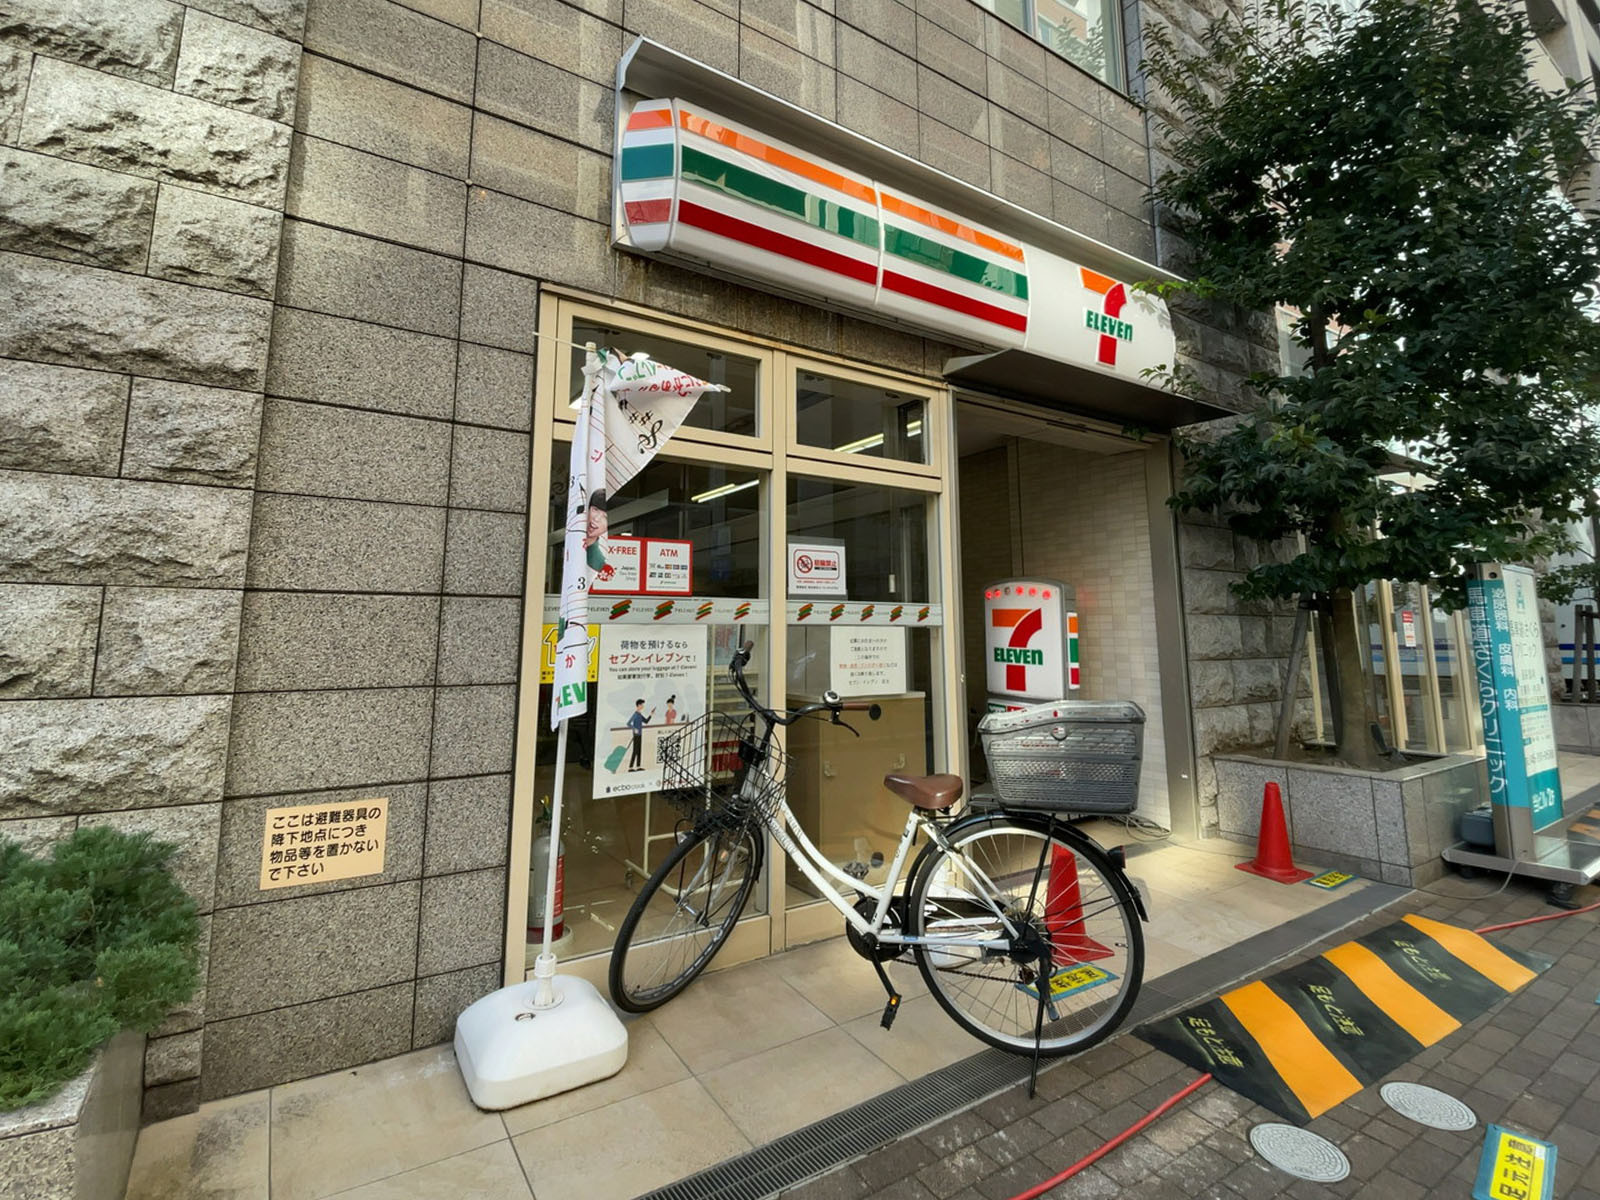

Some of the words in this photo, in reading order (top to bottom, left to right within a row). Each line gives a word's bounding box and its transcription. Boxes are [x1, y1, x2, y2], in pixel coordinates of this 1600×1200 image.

[1080, 267, 1127, 366] 7
[659, 548, 679, 558] ATM
[577, 577, 586, 590] 3
[620, 640, 688, 650] 荷物を預けるなら
[992, 608, 1042, 691] 7
[564, 653, 577, 669] か
[557, 681, 587, 709] EV
[1503, 688, 1519, 711] 内科
[272, 807, 381, 830] ここは避難器具の
[271, 824, 367, 847] 降下地点につき
[269, 839, 379, 864] 物品等を置かない
[268, 862, 325, 881] で下さい
[1499, 1138, 1534, 1200] 足元注意
